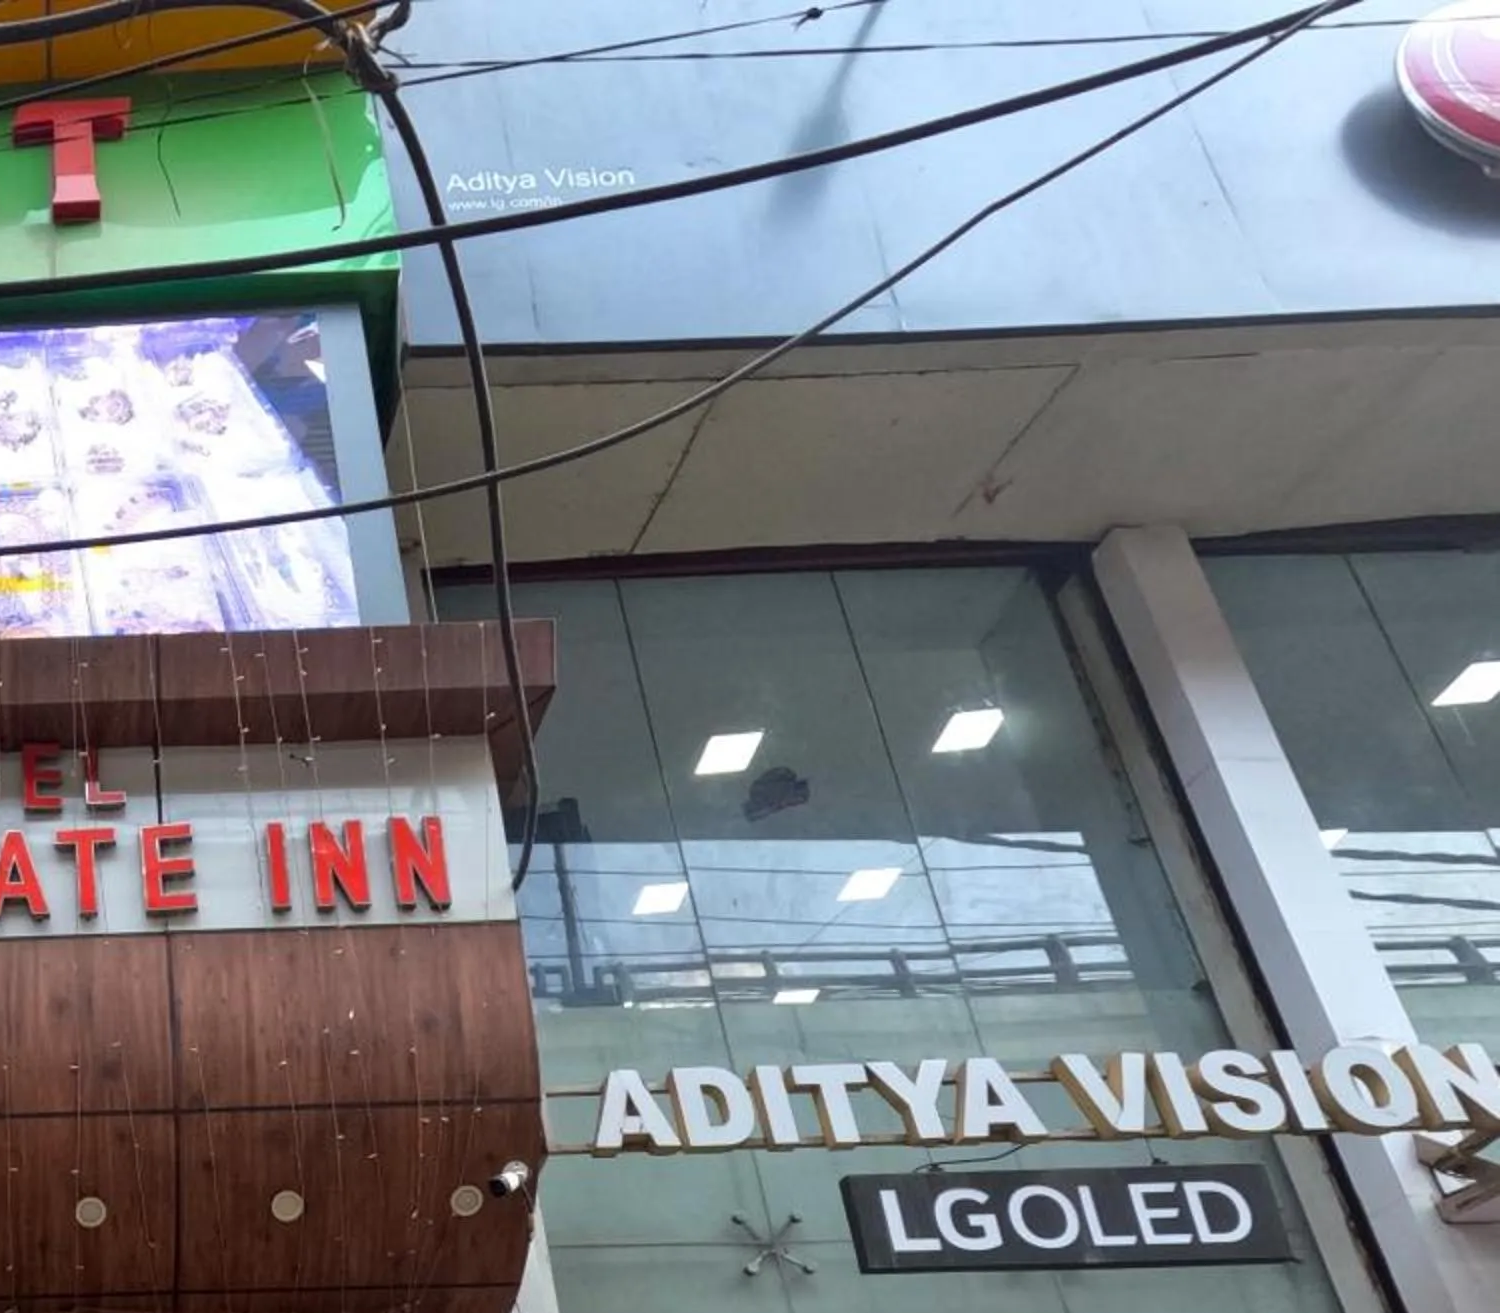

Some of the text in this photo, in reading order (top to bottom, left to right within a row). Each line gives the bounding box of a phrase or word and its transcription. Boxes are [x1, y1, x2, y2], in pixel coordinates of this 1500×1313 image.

[446, 166, 636, 194] Aditya Vision
[265, 816, 454, 916] INN
[594, 1042, 1500, 1157] ADITYA VISION
